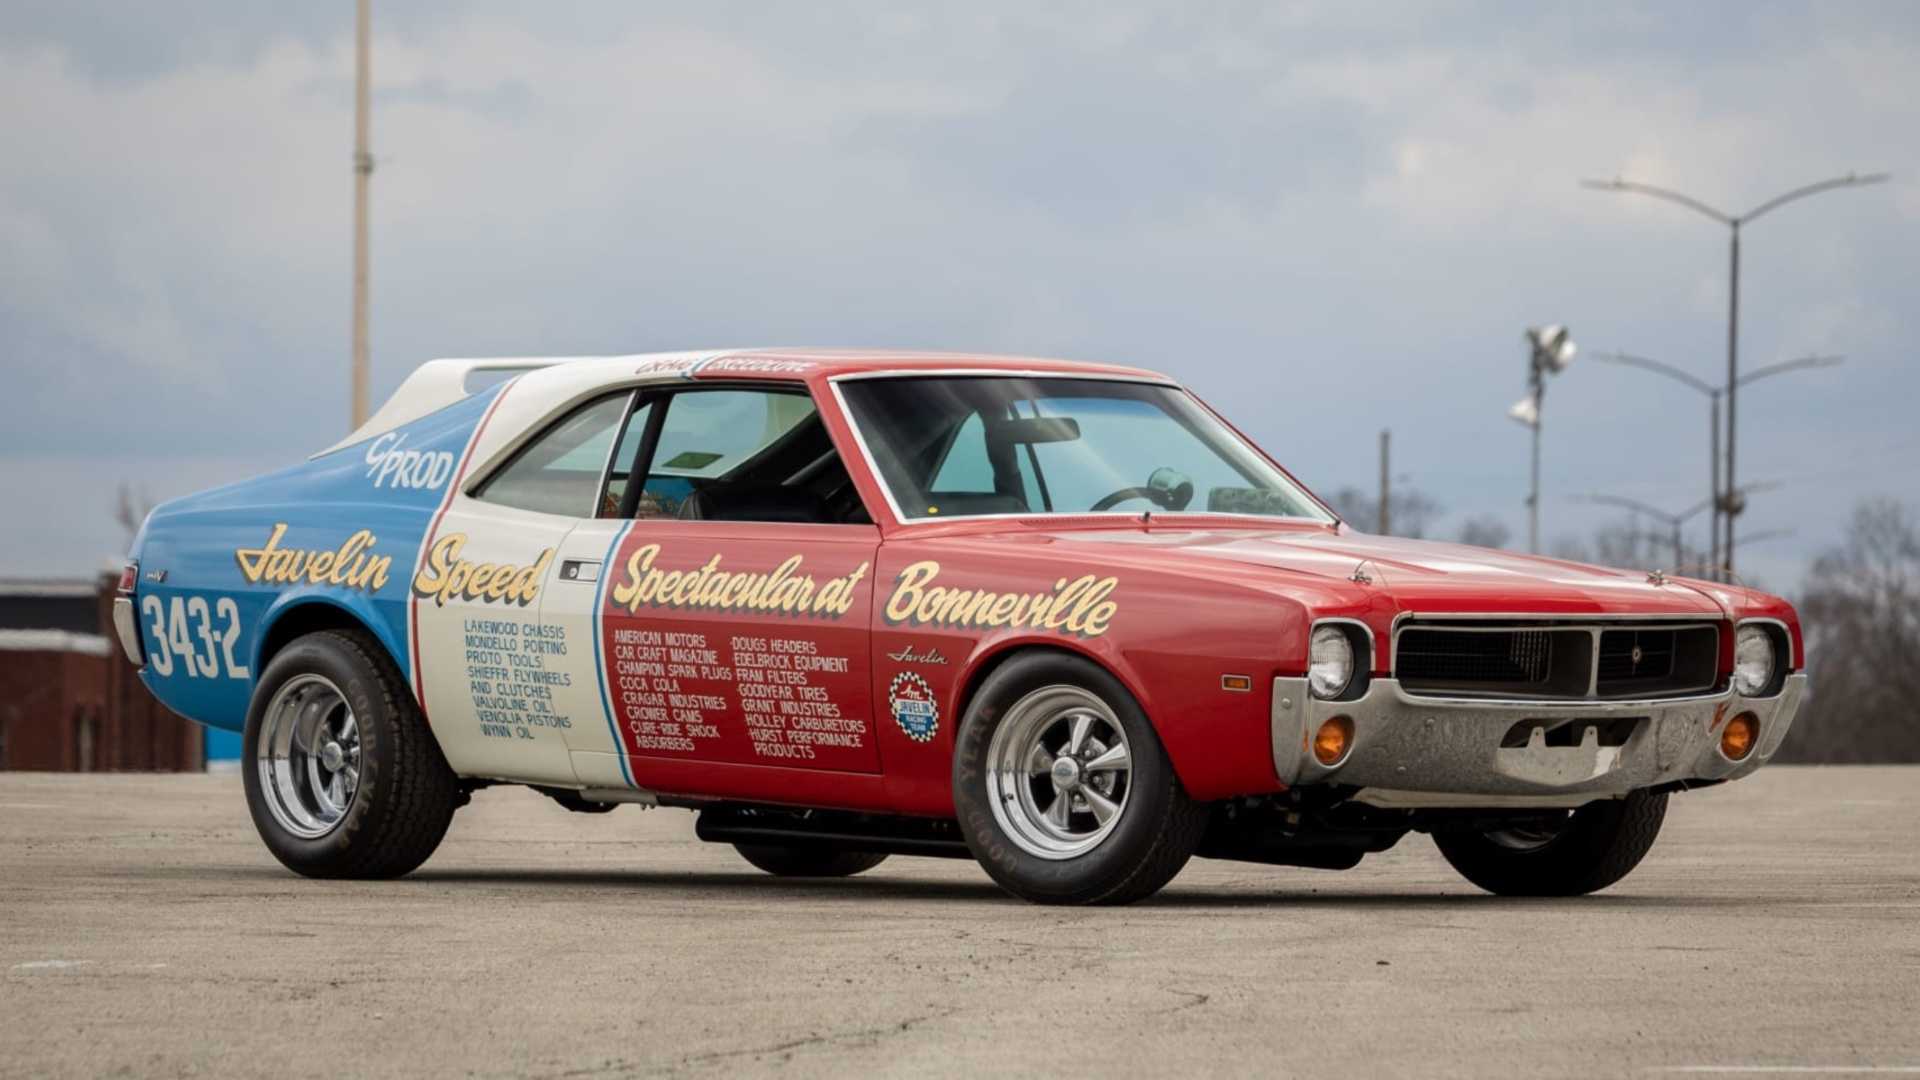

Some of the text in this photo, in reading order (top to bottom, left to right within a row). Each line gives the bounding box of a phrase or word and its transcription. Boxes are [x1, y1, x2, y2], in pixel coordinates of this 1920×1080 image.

[365, 432, 454, 489] C/PROD
[236, 523, 554, 604] Javelin Speed
[613, 544, 869, 616] Spectacular at
[884, 560, 1118, 636] Bonneville
[142, 594, 250, 679] 343-2
[465, 620, 564, 639] LAKEWOOD CHASSIS
[615, 630, 705, 647] AMERICAN MOTORS
[466, 635, 566, 655] MONDELLO PORTING
[732, 637, 817, 654] DOUGS HEADERS
[467, 651, 541, 668] PROTO TOOLS
[616, 646, 718, 664] CAR CRAFT MAGAZINE
[734, 653, 848, 672] EDELBROCK EQUIPMENT
[888, 646, 948, 664] Javelin
[514, 669, 571, 686] FLYWHEELS
[618, 661, 731, 680] CHAMPION SPARK PLUGS
[736, 669, 807, 685] FRAM FILTERS
[471, 681, 551, 699] AND CLUTCHES
[620, 677, 680, 691] COCA COLA
[739, 684, 828, 701] GOODYEAR TIRES
[474, 696, 550, 713] VALVOLINE OIL
[623, 692, 727, 709] CRAGAR INDUSTRIES
[742, 699, 840, 717] GRANT INDUSTRIES
[477, 710, 572, 728] VENOLIA PISTONS
[627, 706, 703, 723] CROWER CAMS
[745, 714, 866, 733] HOLLEY CARBURETORS
[516, 727, 535, 739] OIL
[686, 724, 720, 737] SHOCK
[749, 728, 863, 747] HURST PERFORMANCE
[636, 735, 695, 751] ABSORBERS
[754, 743, 815, 759] PRODUCTS
